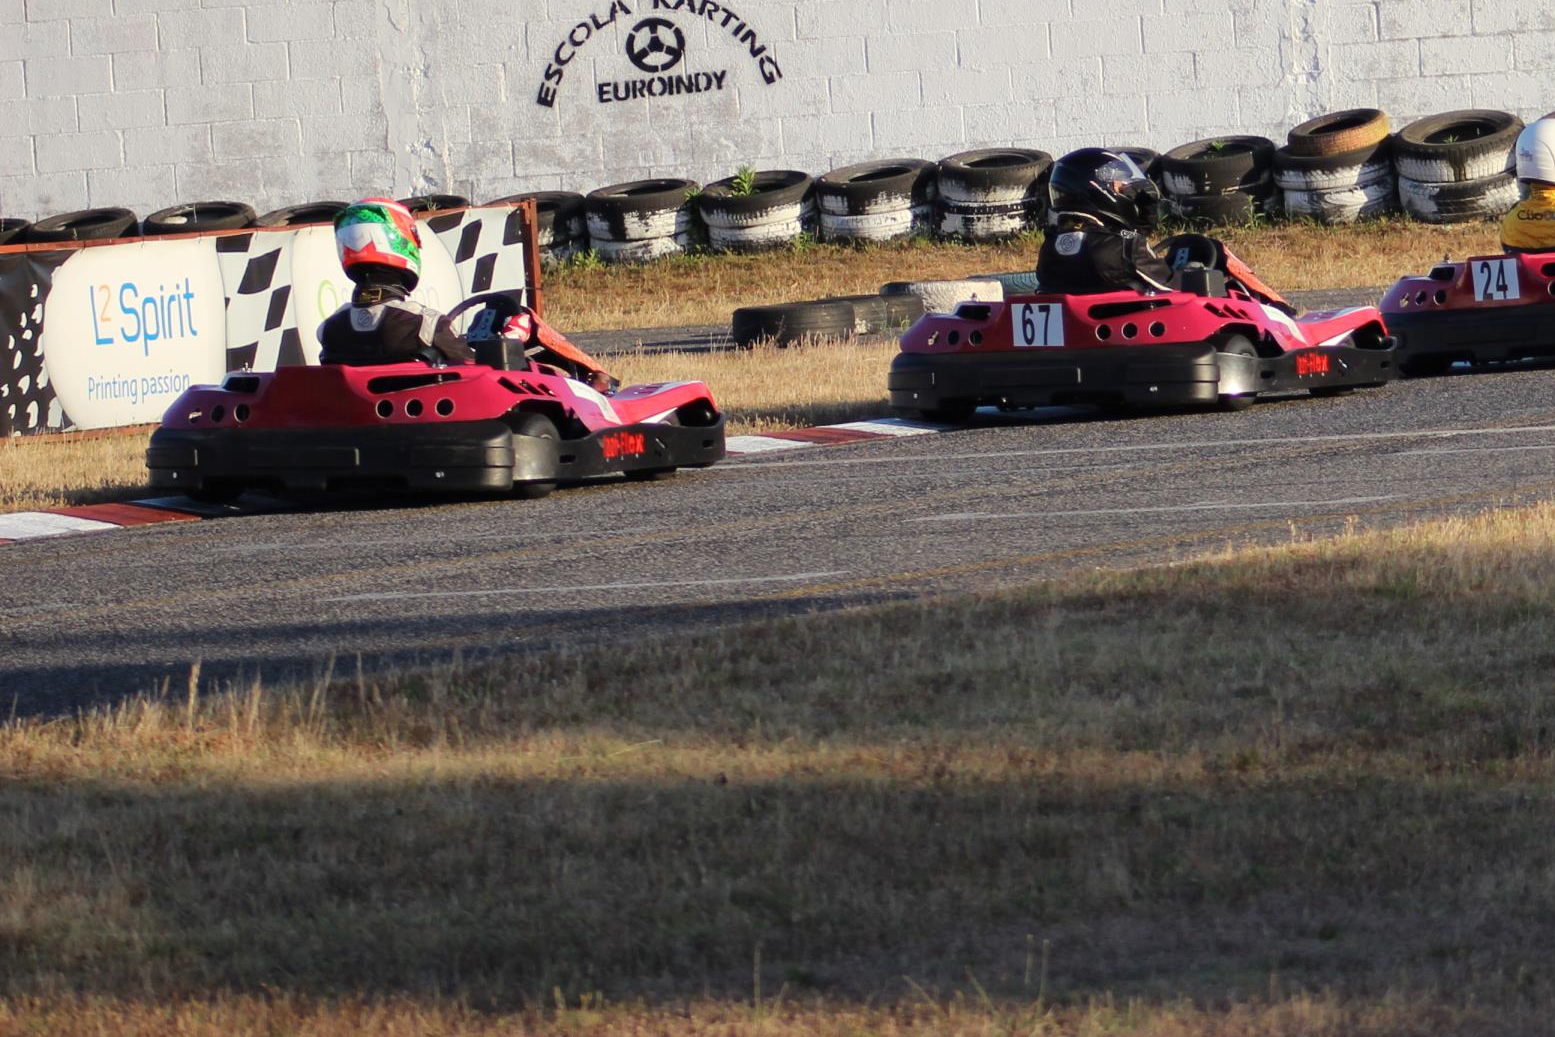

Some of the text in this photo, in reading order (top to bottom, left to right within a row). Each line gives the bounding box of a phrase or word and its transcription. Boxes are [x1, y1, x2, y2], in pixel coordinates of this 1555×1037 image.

[536, 0, 632, 108] ESCOLA
[598, 69, 727, 103] EUROINDY
[1480, 259, 1508, 301] 24
[119, 277, 198, 356] Spirit
[1022, 303, 1050, 346] 67
[88, 368, 191, 405] Printing passion
